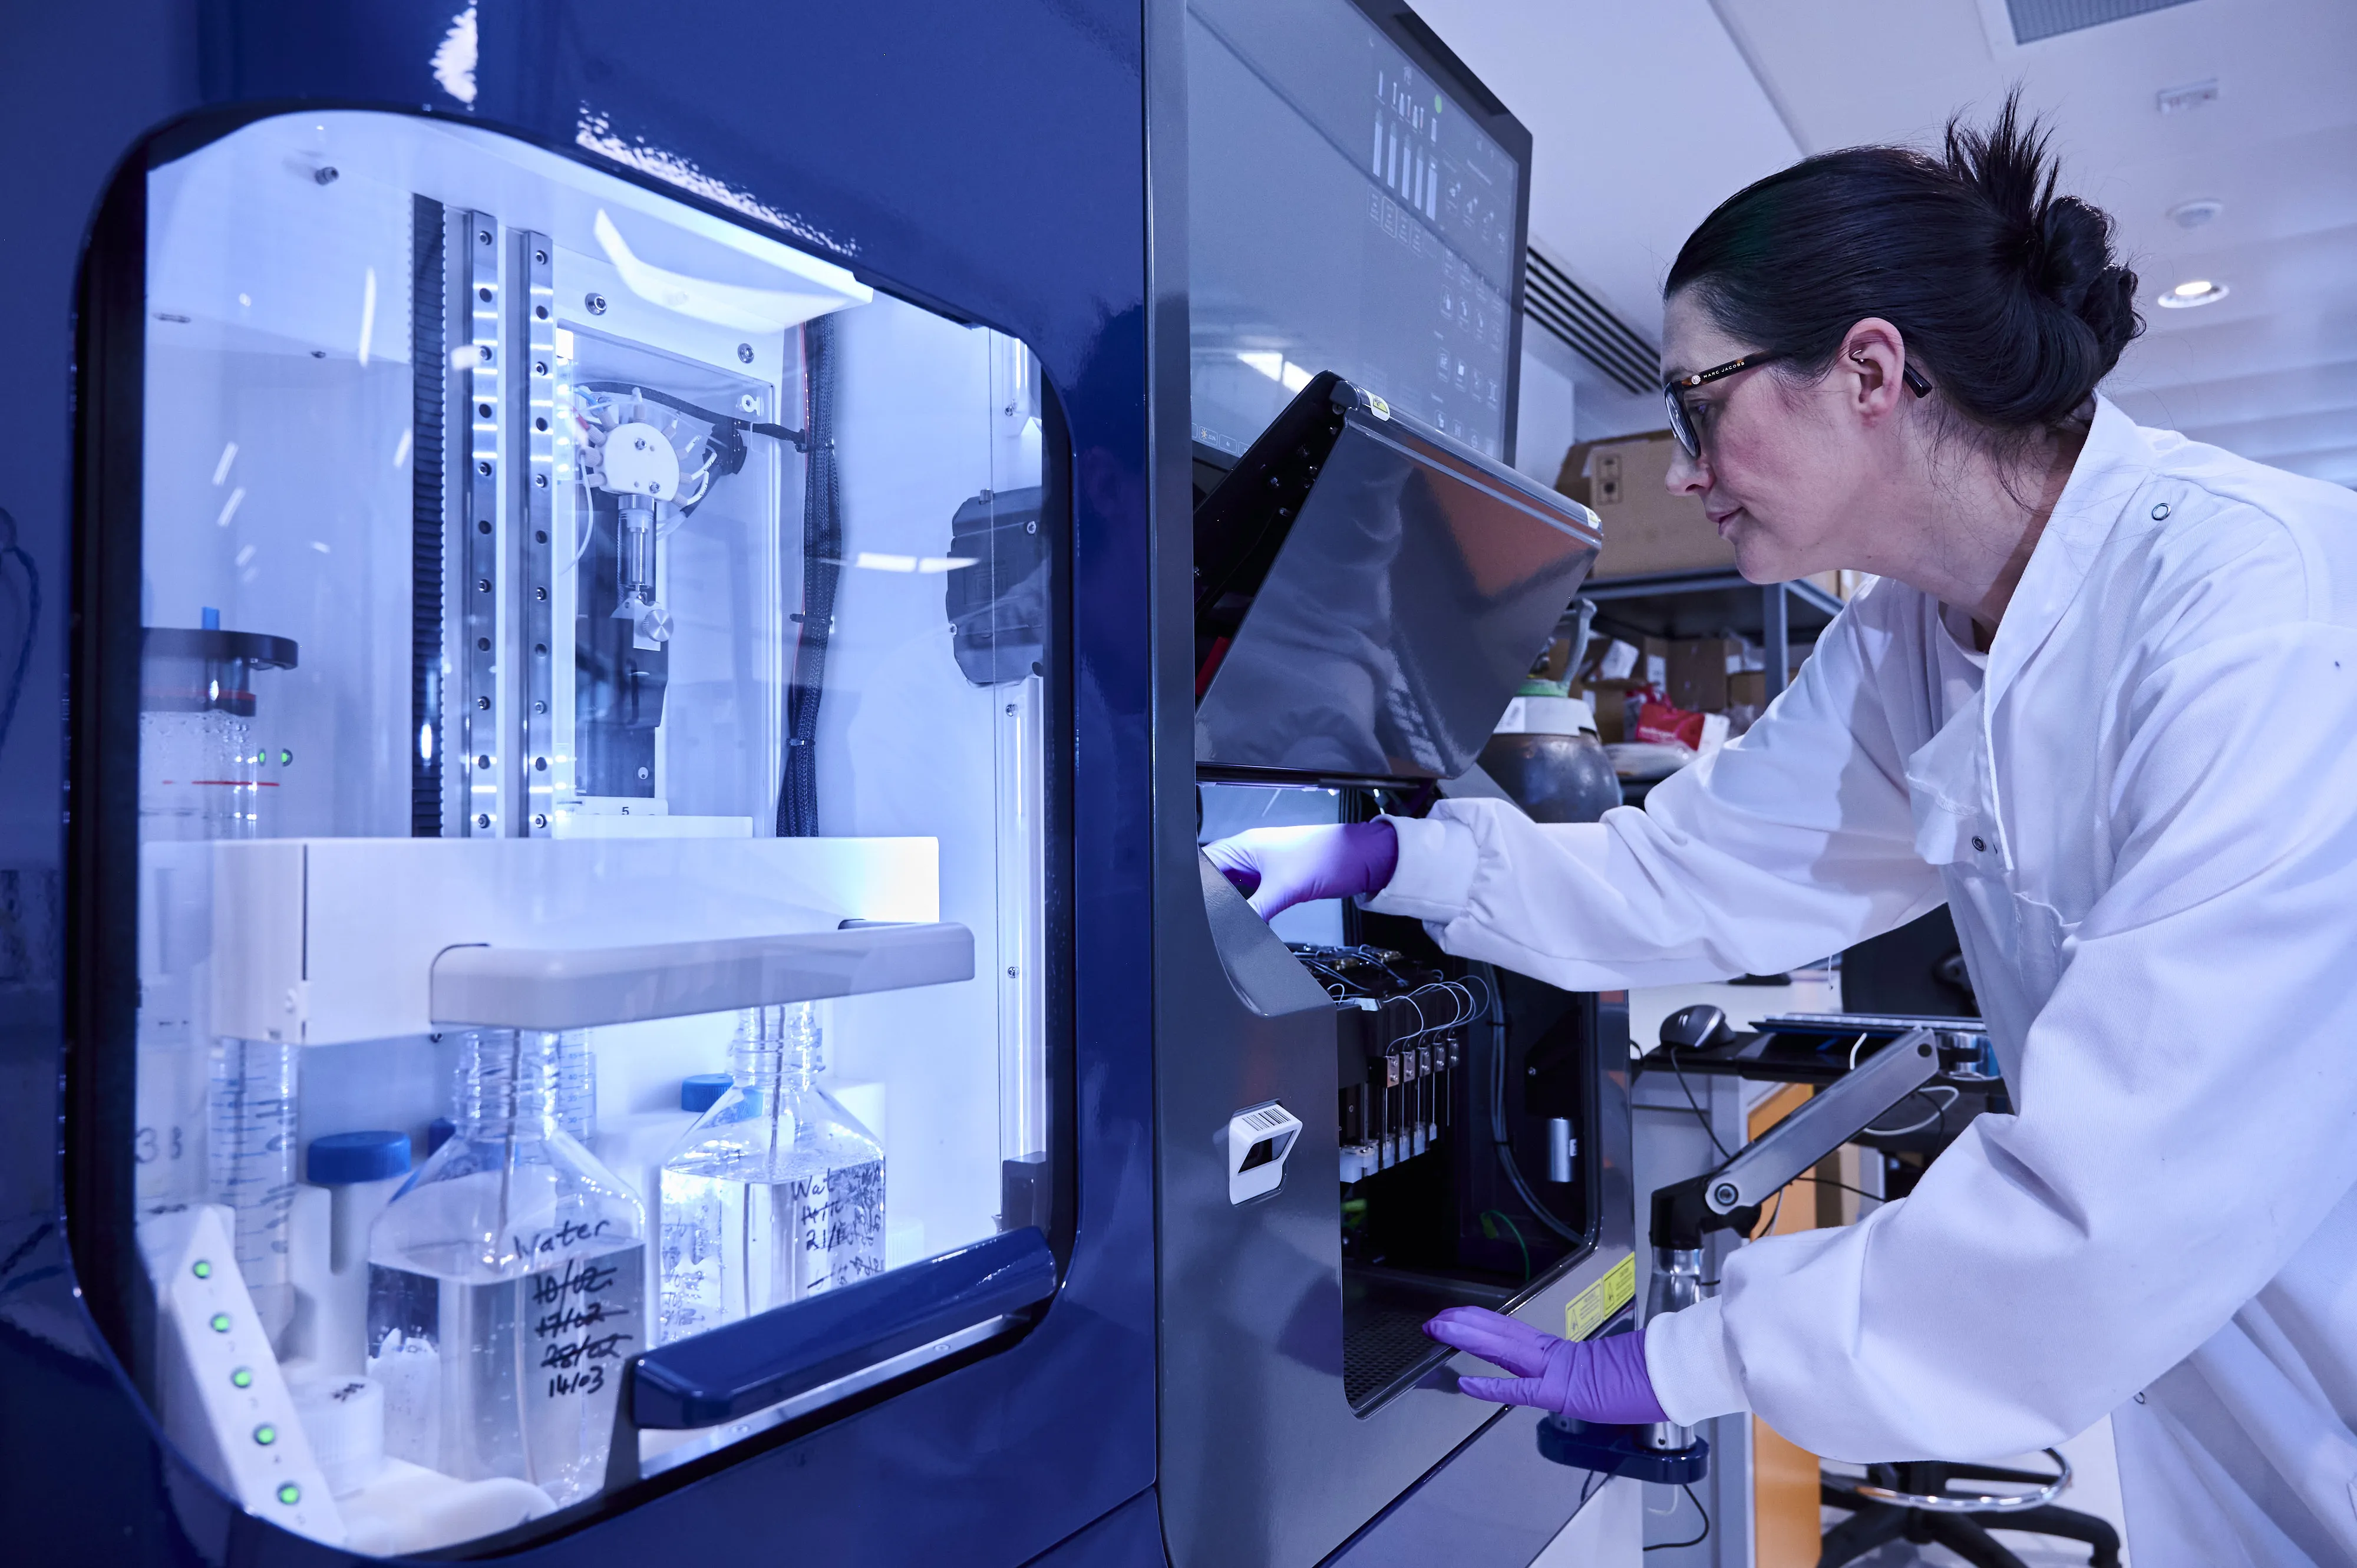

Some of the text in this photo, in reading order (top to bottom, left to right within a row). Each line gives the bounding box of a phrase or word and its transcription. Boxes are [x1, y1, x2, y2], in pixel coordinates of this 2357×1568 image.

[1703, 361, 1745, 378] MARC JACOBS
[622, 806, 629, 815] 5
[514, 1219, 610, 1261] Water
[549, 1365, 605, 1398] 14/03
